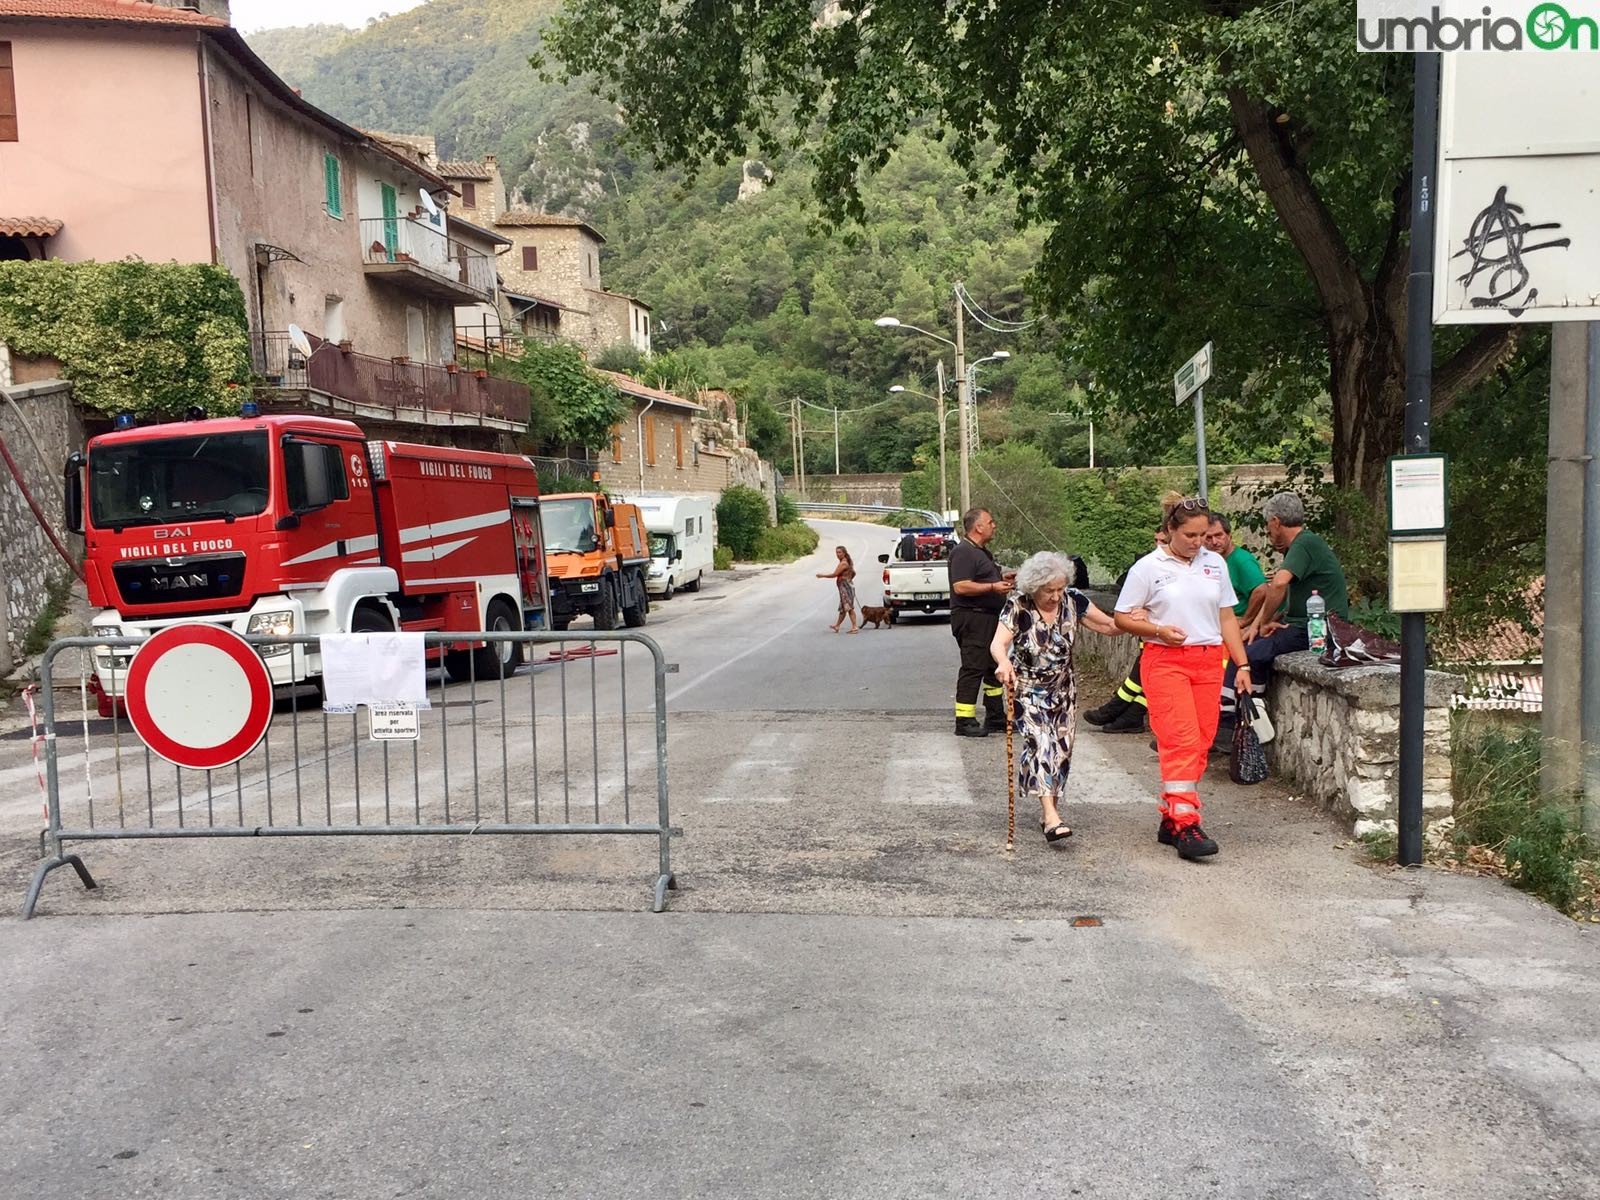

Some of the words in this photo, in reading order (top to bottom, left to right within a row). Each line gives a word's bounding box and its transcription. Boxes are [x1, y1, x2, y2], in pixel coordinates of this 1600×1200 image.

[419, 461, 448, 477] VIGILI
[449, 466, 466, 479] DEL
[468, 467, 493, 481] FUOCO
[153, 526, 192, 539] BAI
[120, 545, 158, 559] VIGILI
[163, 542, 188, 555] DEL
[193, 538, 233, 552] FUOCO
[151, 573, 209, 591] MAN
